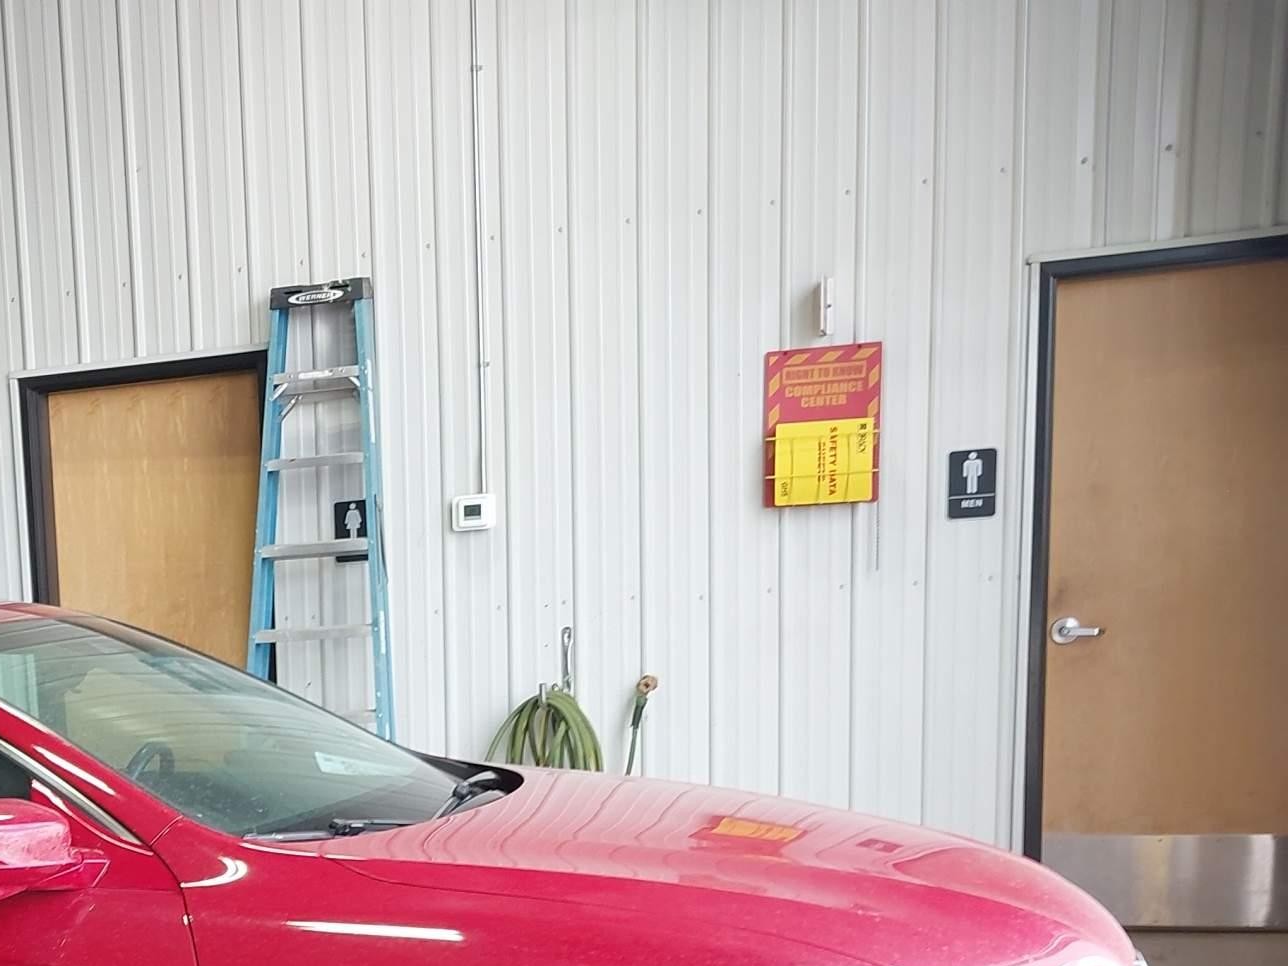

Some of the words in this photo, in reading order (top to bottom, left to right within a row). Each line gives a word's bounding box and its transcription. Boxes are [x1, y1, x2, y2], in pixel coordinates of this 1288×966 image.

[785, 380, 863, 398] COMPLIANCE
[800, 394, 847, 408] CENTER
[828, 425, 840, 466] SAFETY
[827, 470, 838, 496] DATA
[961, 498, 983, 509] MEN
